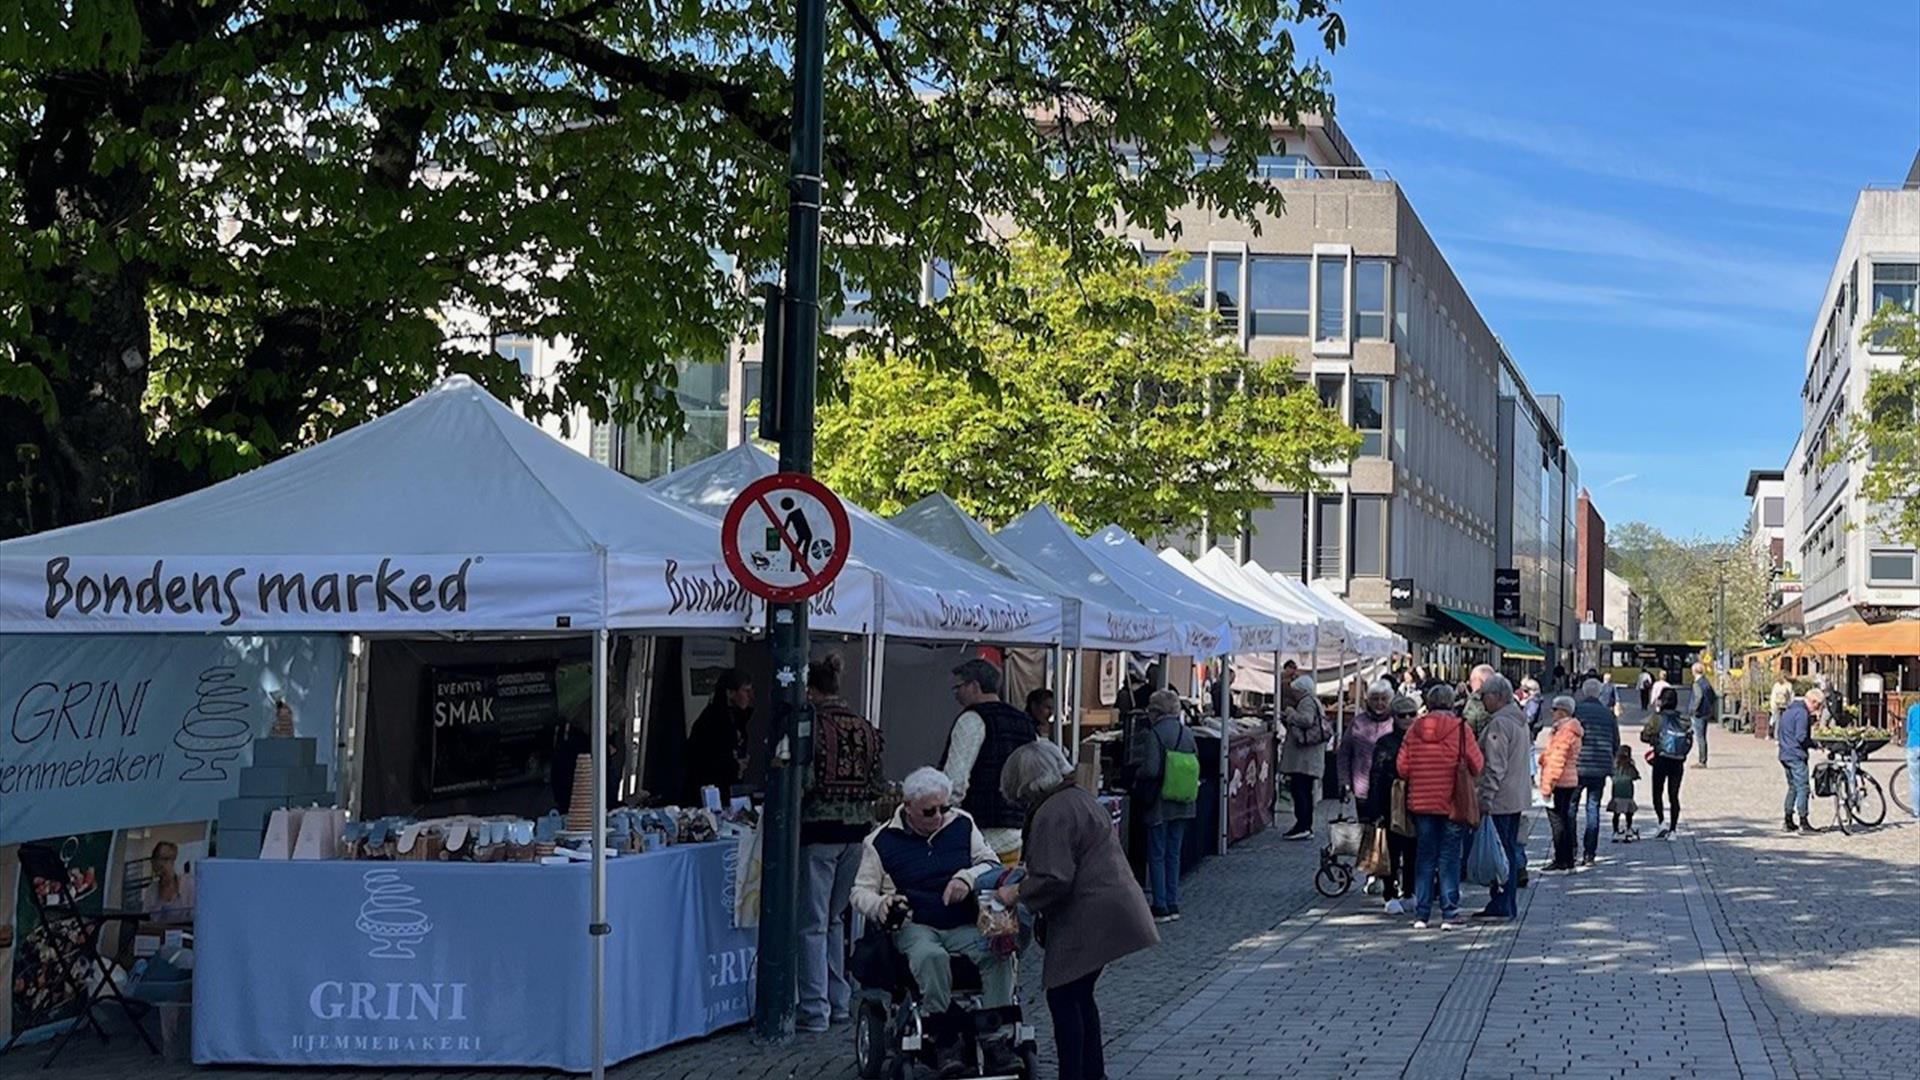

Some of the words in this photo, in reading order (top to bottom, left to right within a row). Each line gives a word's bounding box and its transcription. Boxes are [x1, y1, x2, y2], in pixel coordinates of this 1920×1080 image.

[45, 556, 246, 627] Bondens
[665, 558, 753, 624] Bondens
[437, 681, 483, 696] EVENTYR
[11, 678, 152, 744] GRINI
[434, 696, 496, 728] SMAK
[309, 981, 468, 1020] GRINI
[291, 1034, 482, 1052] HJEMMEBAKERI
